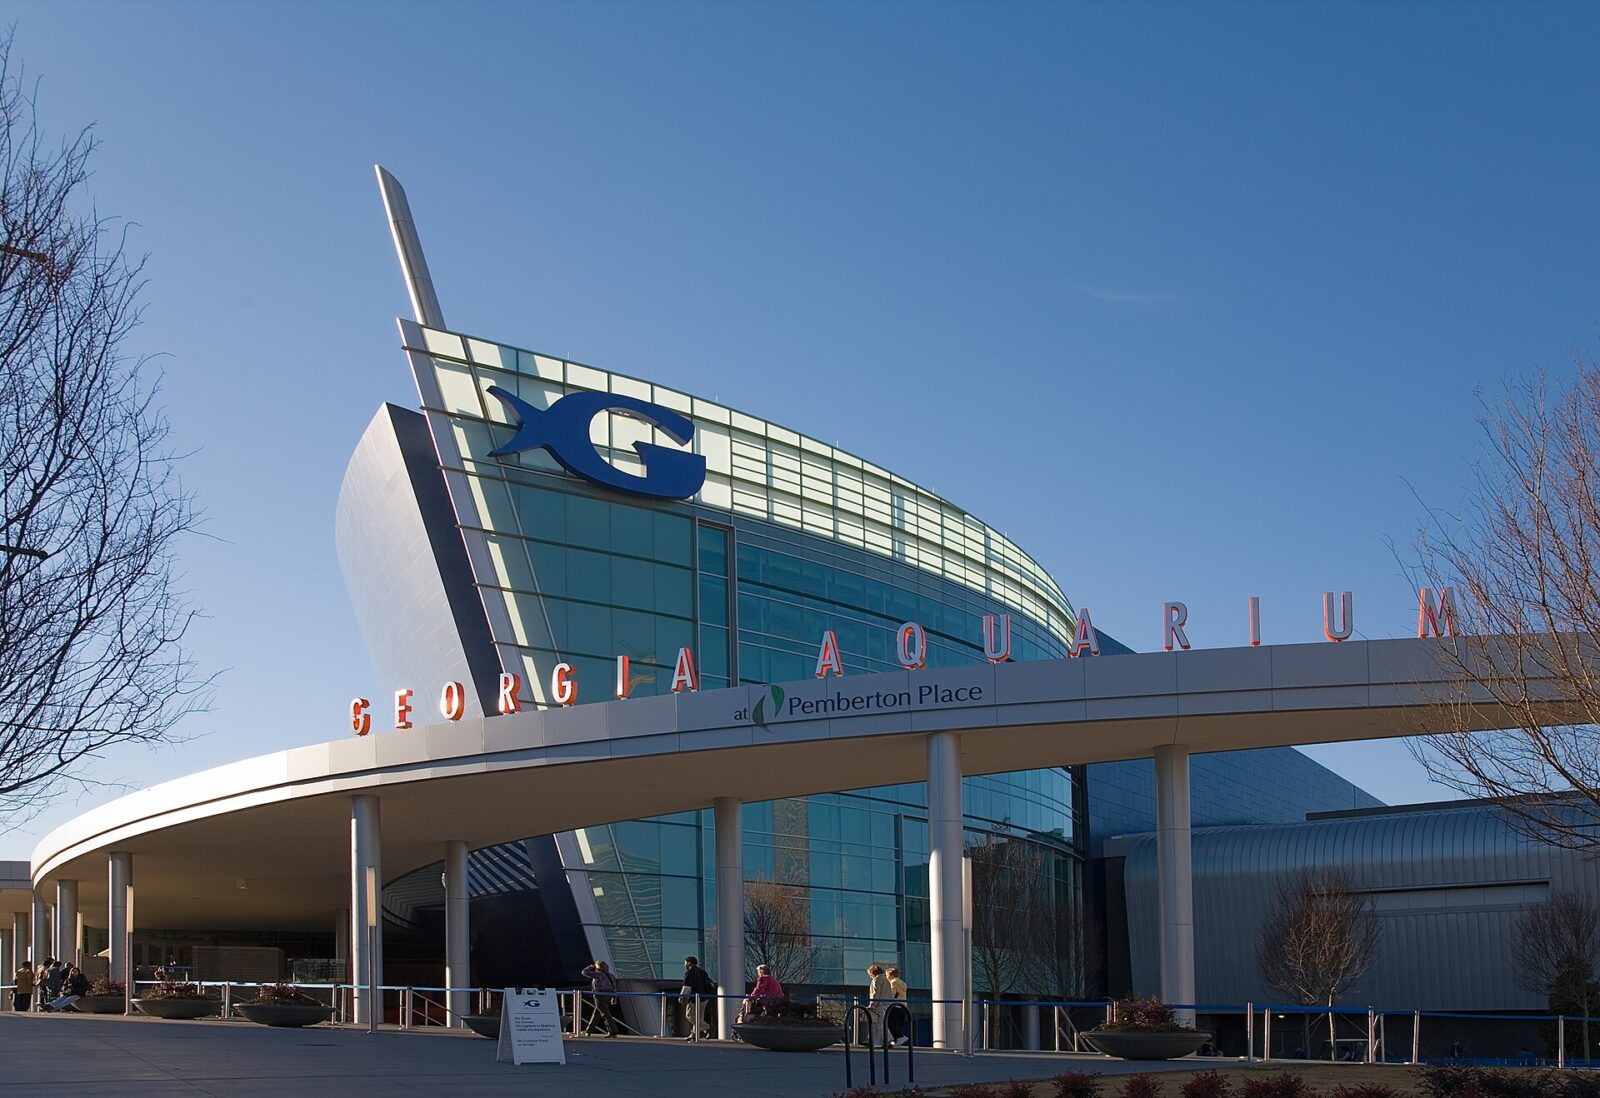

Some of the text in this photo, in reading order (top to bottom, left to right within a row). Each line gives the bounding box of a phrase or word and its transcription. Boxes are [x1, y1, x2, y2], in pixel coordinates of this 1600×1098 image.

[350, 587, 1460, 737] GEORGIA AQUARIUM
[733, 684, 983, 721] at Pemberton Place
